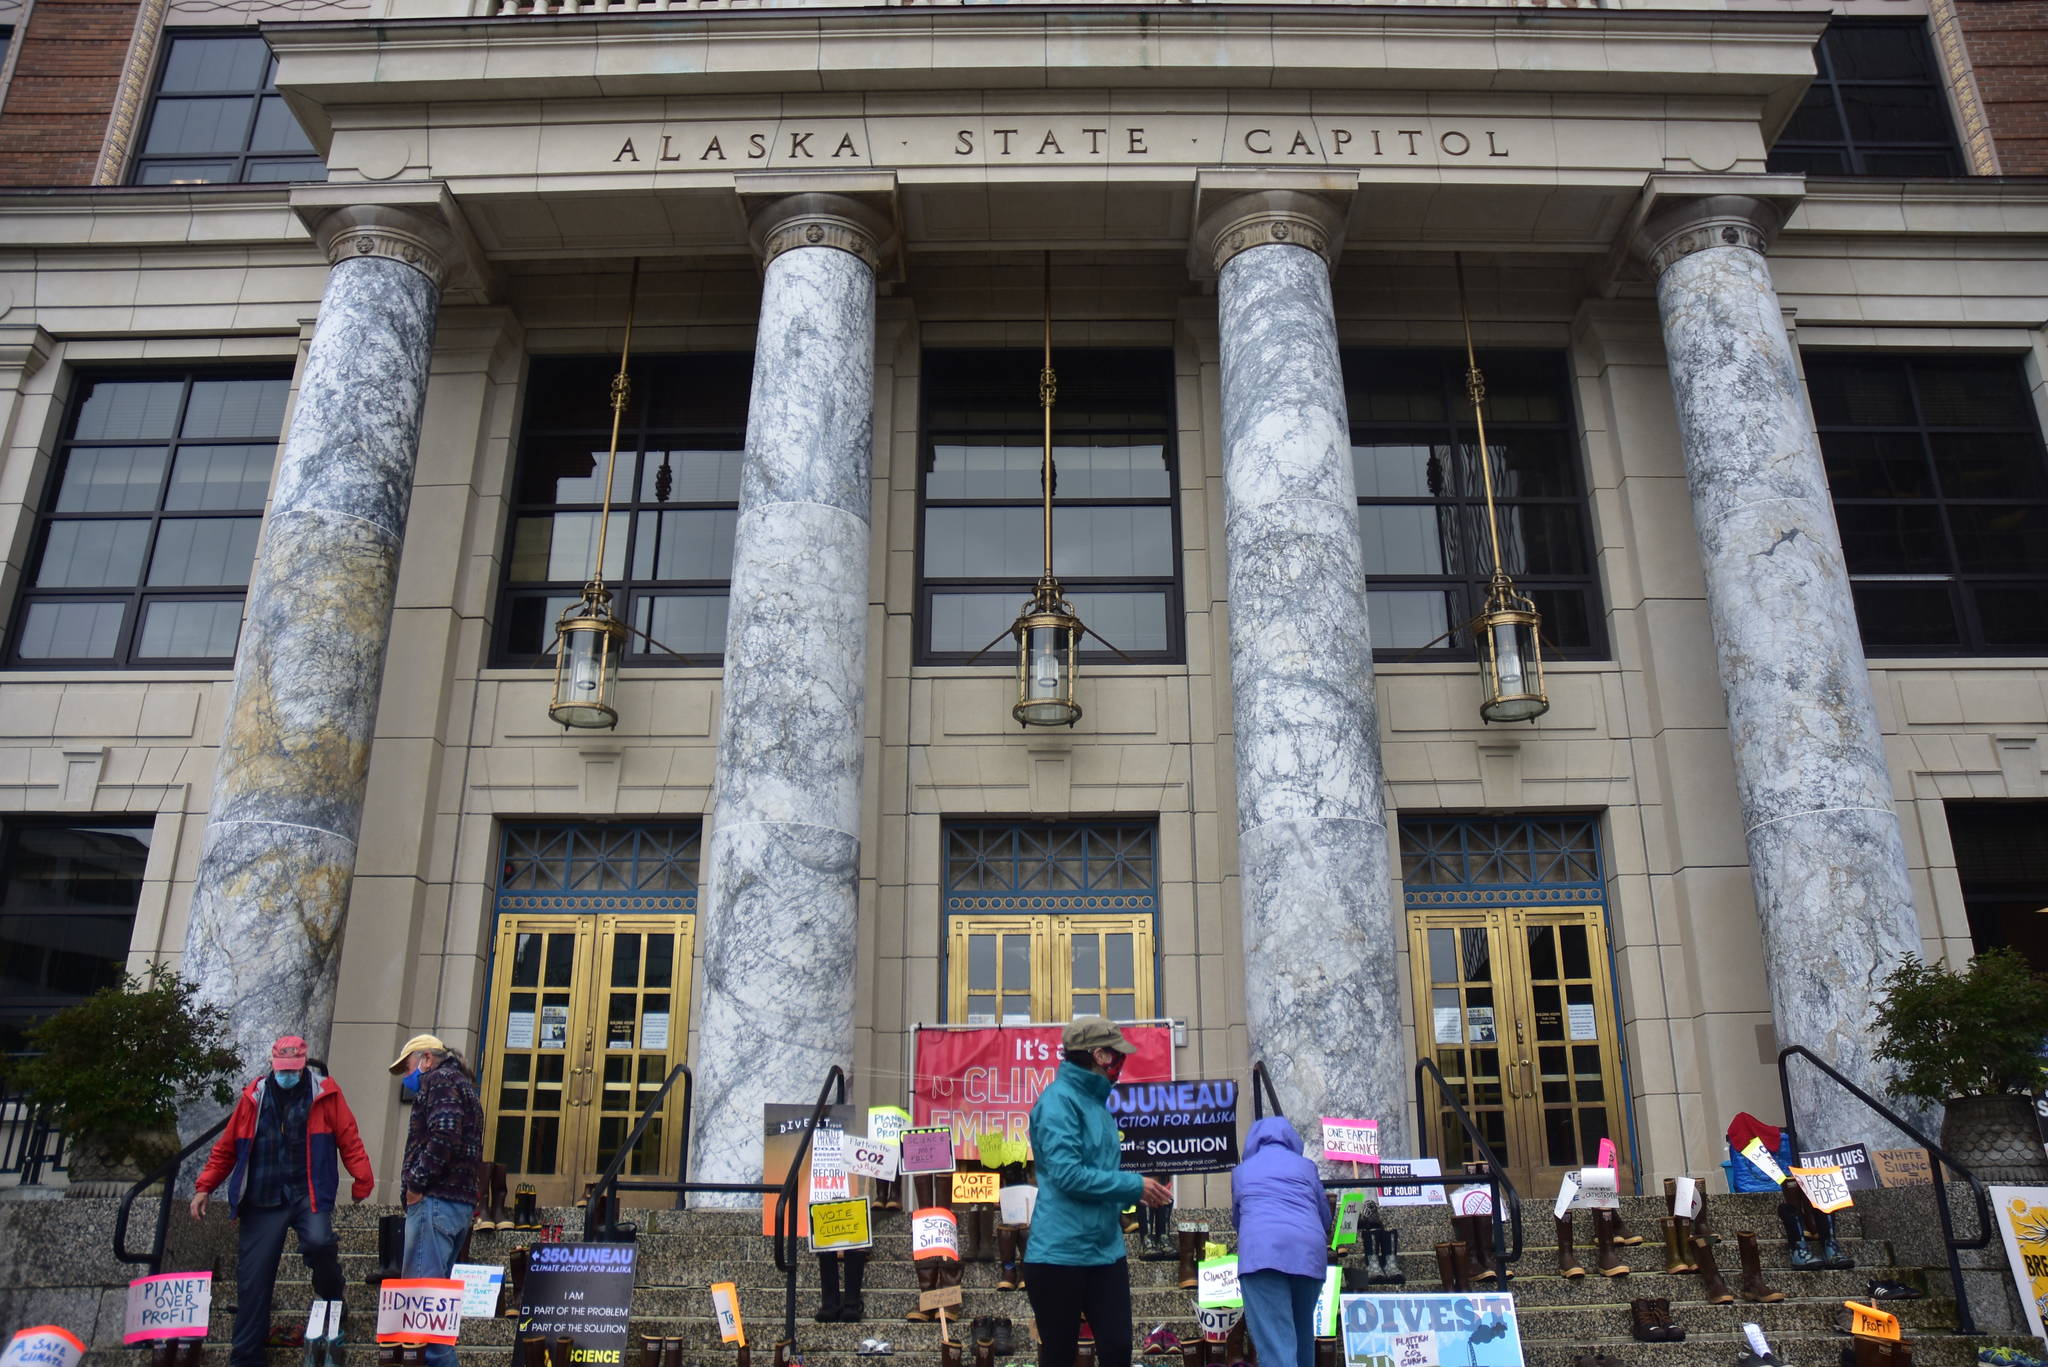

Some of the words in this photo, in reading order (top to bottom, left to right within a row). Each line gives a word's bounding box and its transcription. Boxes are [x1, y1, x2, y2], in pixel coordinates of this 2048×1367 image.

[612, 132, 860, 163] ALASKA
[954, 128, 1149, 156] STATE
[1243, 128, 1510, 158] CAPITOL
[1015, 1038, 1049, 1061] It's
[963, 1067, 1056, 1104] CLIM
[1163, 1112, 1190, 1127] FOR
[1193, 1110, 1237, 1125] ALASKA
[1328, 1127, 1344, 1139] ONE
[1346, 1127, 1377, 1142] EARTH
[1119, 1141, 1136, 1152] art
[1147, 1136, 1228, 1156] SOLUTION
[1326, 1140, 1347, 1151] ONE
[1347, 1142, 1378, 1156] CHANCE
[855, 1149, 884, 1166] CO2
[1801, 1155, 1836, 1168] BLACK
[1837, 1149, 1865, 1164] LIVES
[1879, 1150, 1927, 1161] WHITE
[1380, 1165, 1409, 1175] PROTECT
[1884, 1161, 1929, 1173] SILENC
[814, 1176, 846, 1190] HEAT
[959, 1174, 993, 1186] VOTE
[1806, 1172, 1843, 1190] FOSSIL
[953, 1184, 994, 1200] CLIMATE
[1383, 1186, 1393, 1196] OF
[1394, 1186, 1419, 1196] COLOR!
[1813, 1184, 1849, 1204] FUELS
[819, 1207, 854, 1219] VOTE
[819, 1222, 860, 1235] CLIMATE
[540, 1247, 634, 1264] 350JUNEAU
[530, 1264, 560, 1273] CLIMATE
[561, 1264, 588, 1273] ACTION
[589, 1265, 606, 1273] FOR
[606, 1266, 632, 1274] ALASKA
[155, 1294, 194, 1309] OVER
[568, 1291, 585, 1301] AM
[142, 1304, 199, 1325] PROFIT
[533, 1306, 553, 1317] PART
[554, 1306, 570, 1317] OF
[571, 1307, 586, 1317] THE
[587, 1307, 629, 1318] PROBLEM
[1198, 1311, 1239, 1329] VOTE
[1344, 1297, 1512, 1333] DIVEST
[402, 1310, 458, 1332] NOW!!
[531, 1323, 551, 1333] PART
[553, 1323, 567, 1333] OF
[567, 1324, 583, 1334] THE
[584, 1323, 627, 1335] SOLUTION
[1861, 1314, 1893, 1334] PROFIT
